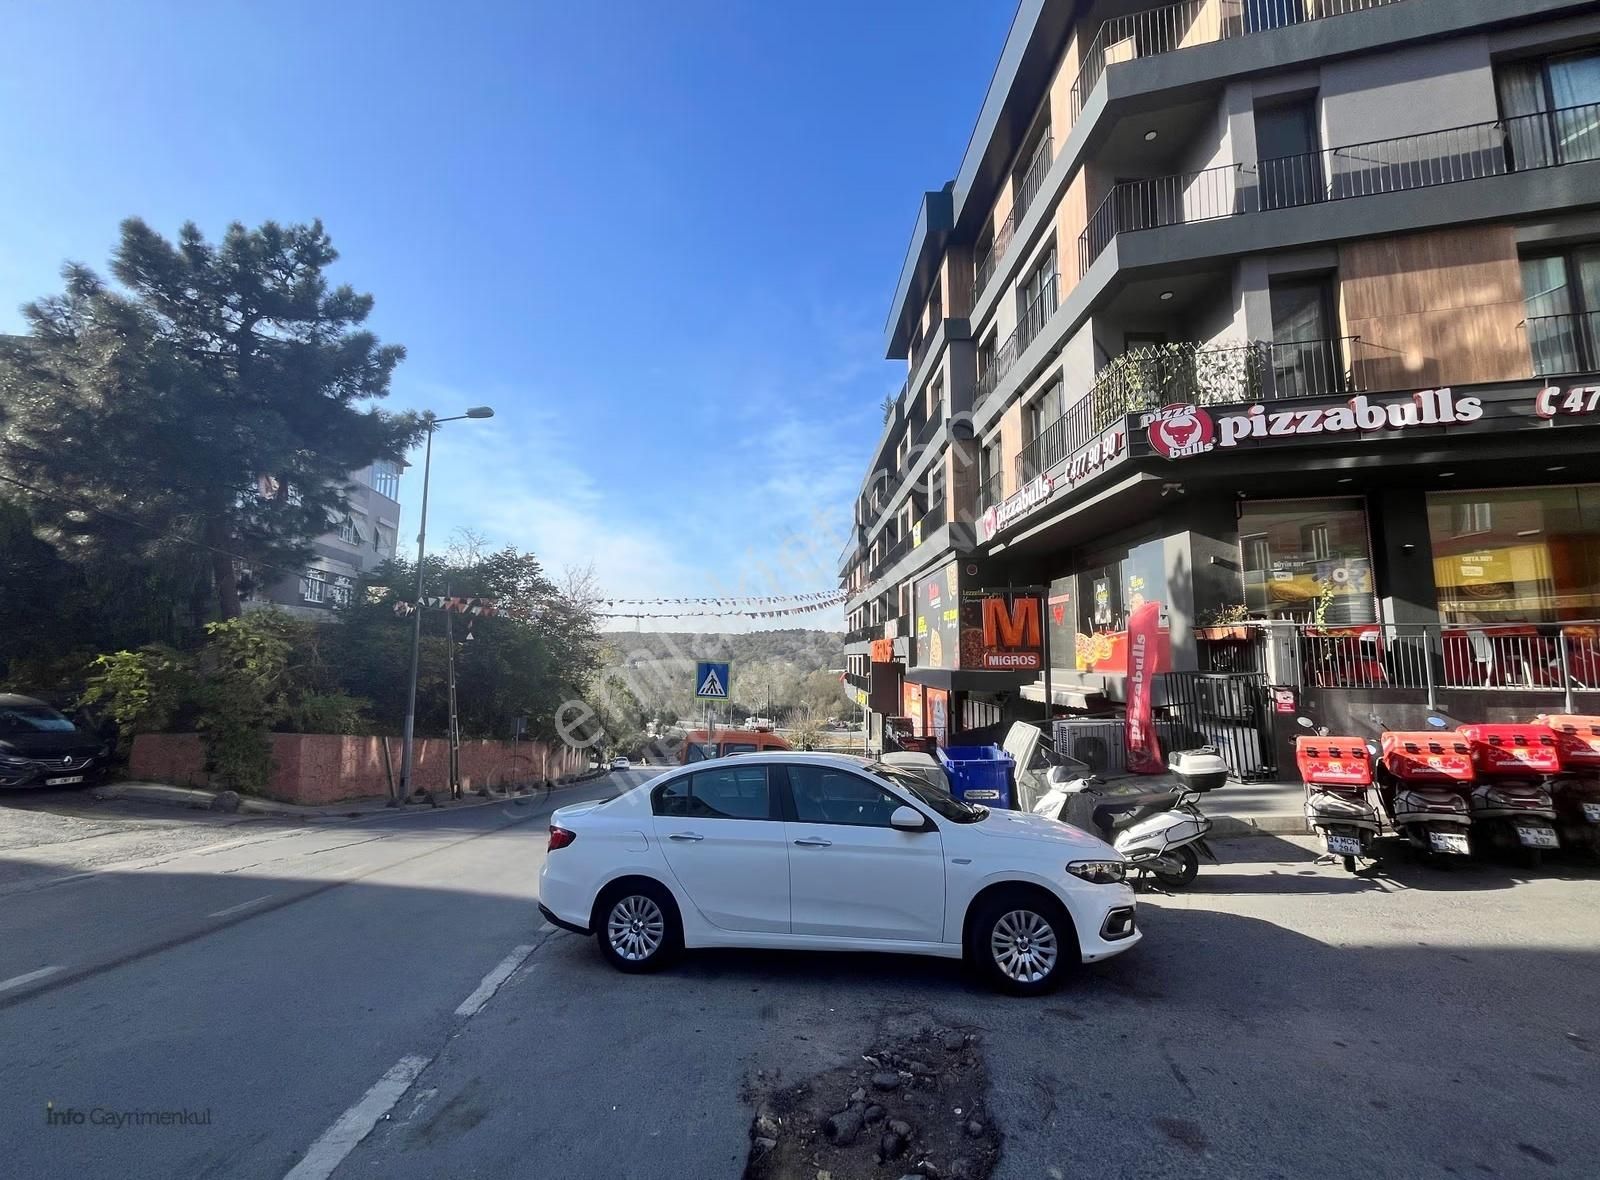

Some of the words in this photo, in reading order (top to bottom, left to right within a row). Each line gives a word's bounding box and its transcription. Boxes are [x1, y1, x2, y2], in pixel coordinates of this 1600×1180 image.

[1140, 405, 1197, 428] pizza
[1218, 387, 1484, 447] pizzabulls
[1169, 441, 1214, 459] bulls
[996, 475, 1051, 530] pizzabulls
[981, 597, 1040, 648] M
[1132, 634, 1146, 741] pizzabulls
